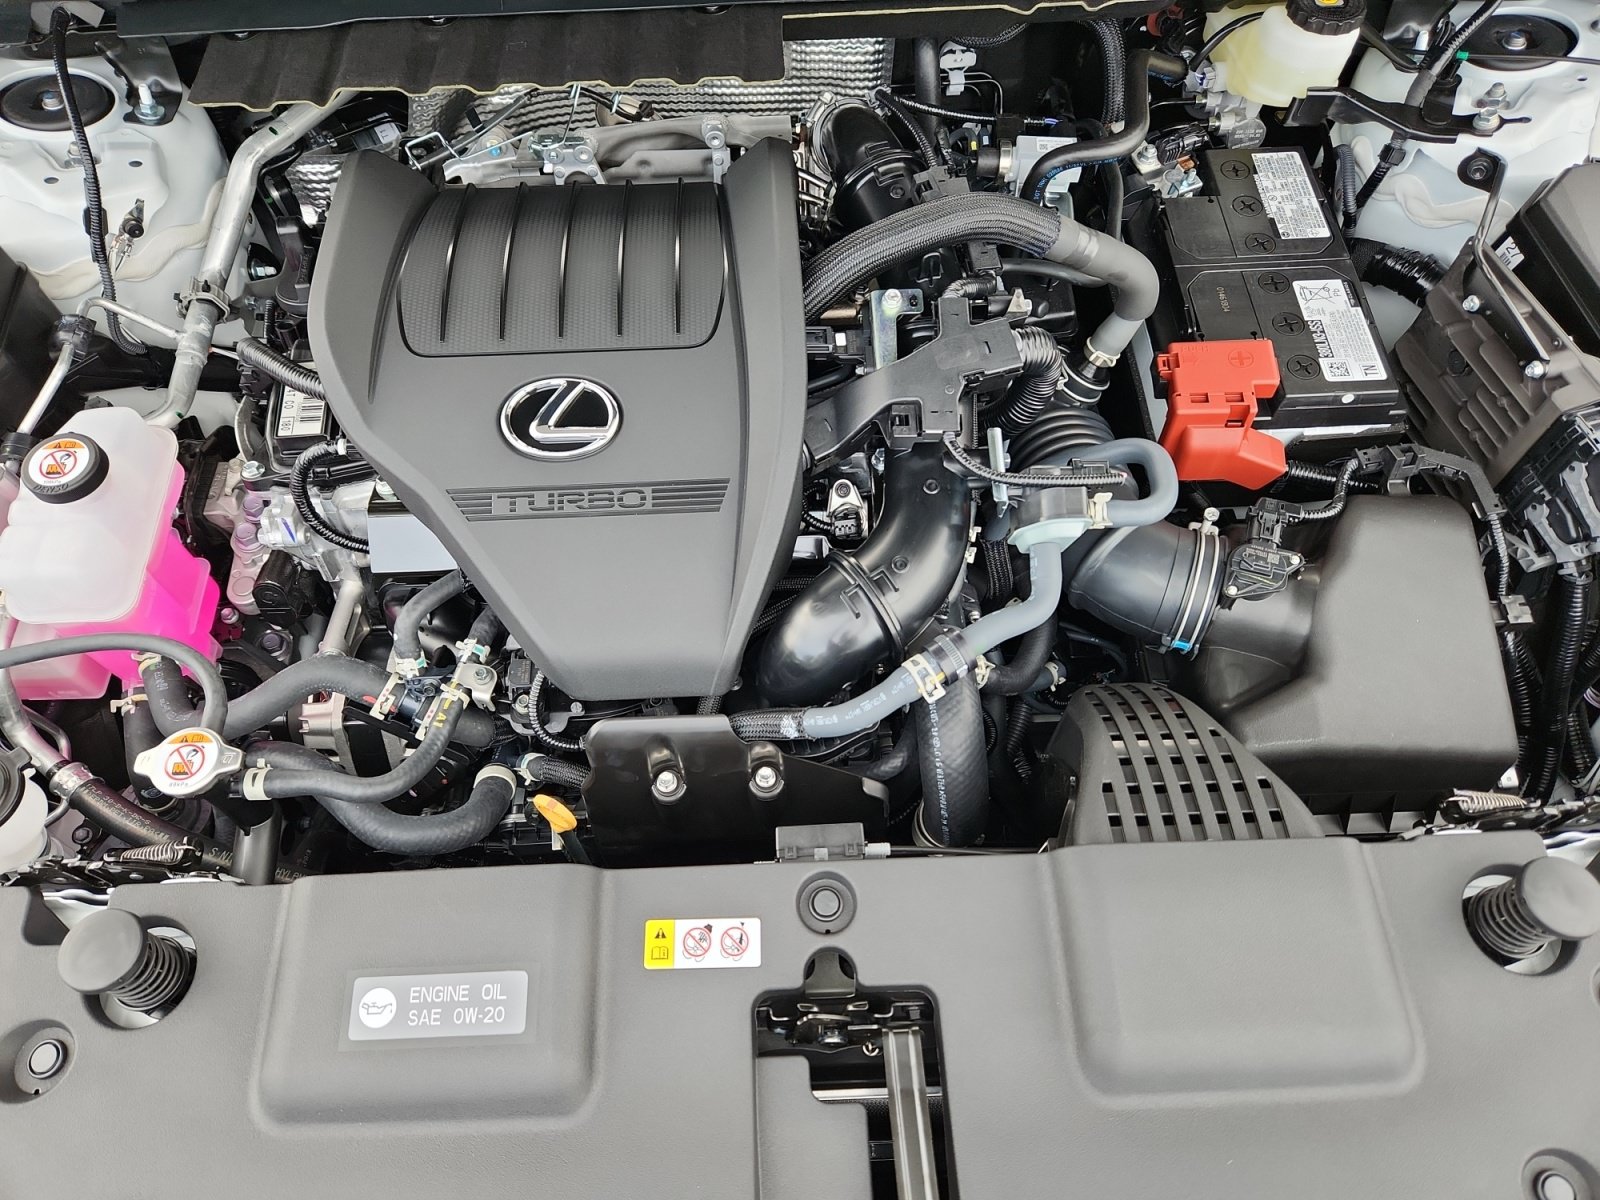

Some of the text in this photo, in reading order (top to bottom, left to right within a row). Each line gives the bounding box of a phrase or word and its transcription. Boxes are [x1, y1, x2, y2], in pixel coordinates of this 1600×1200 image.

[1332, 288, 1341, 297] Pb
[1362, 364, 1378, 377] TN
[32, 483, 69, 493] DENSO
[496, 489, 647, 513] TURBO
[409, 983, 507, 1003] ENGINE OIL
[407, 1006, 505, 1026] SAE 0W-20
